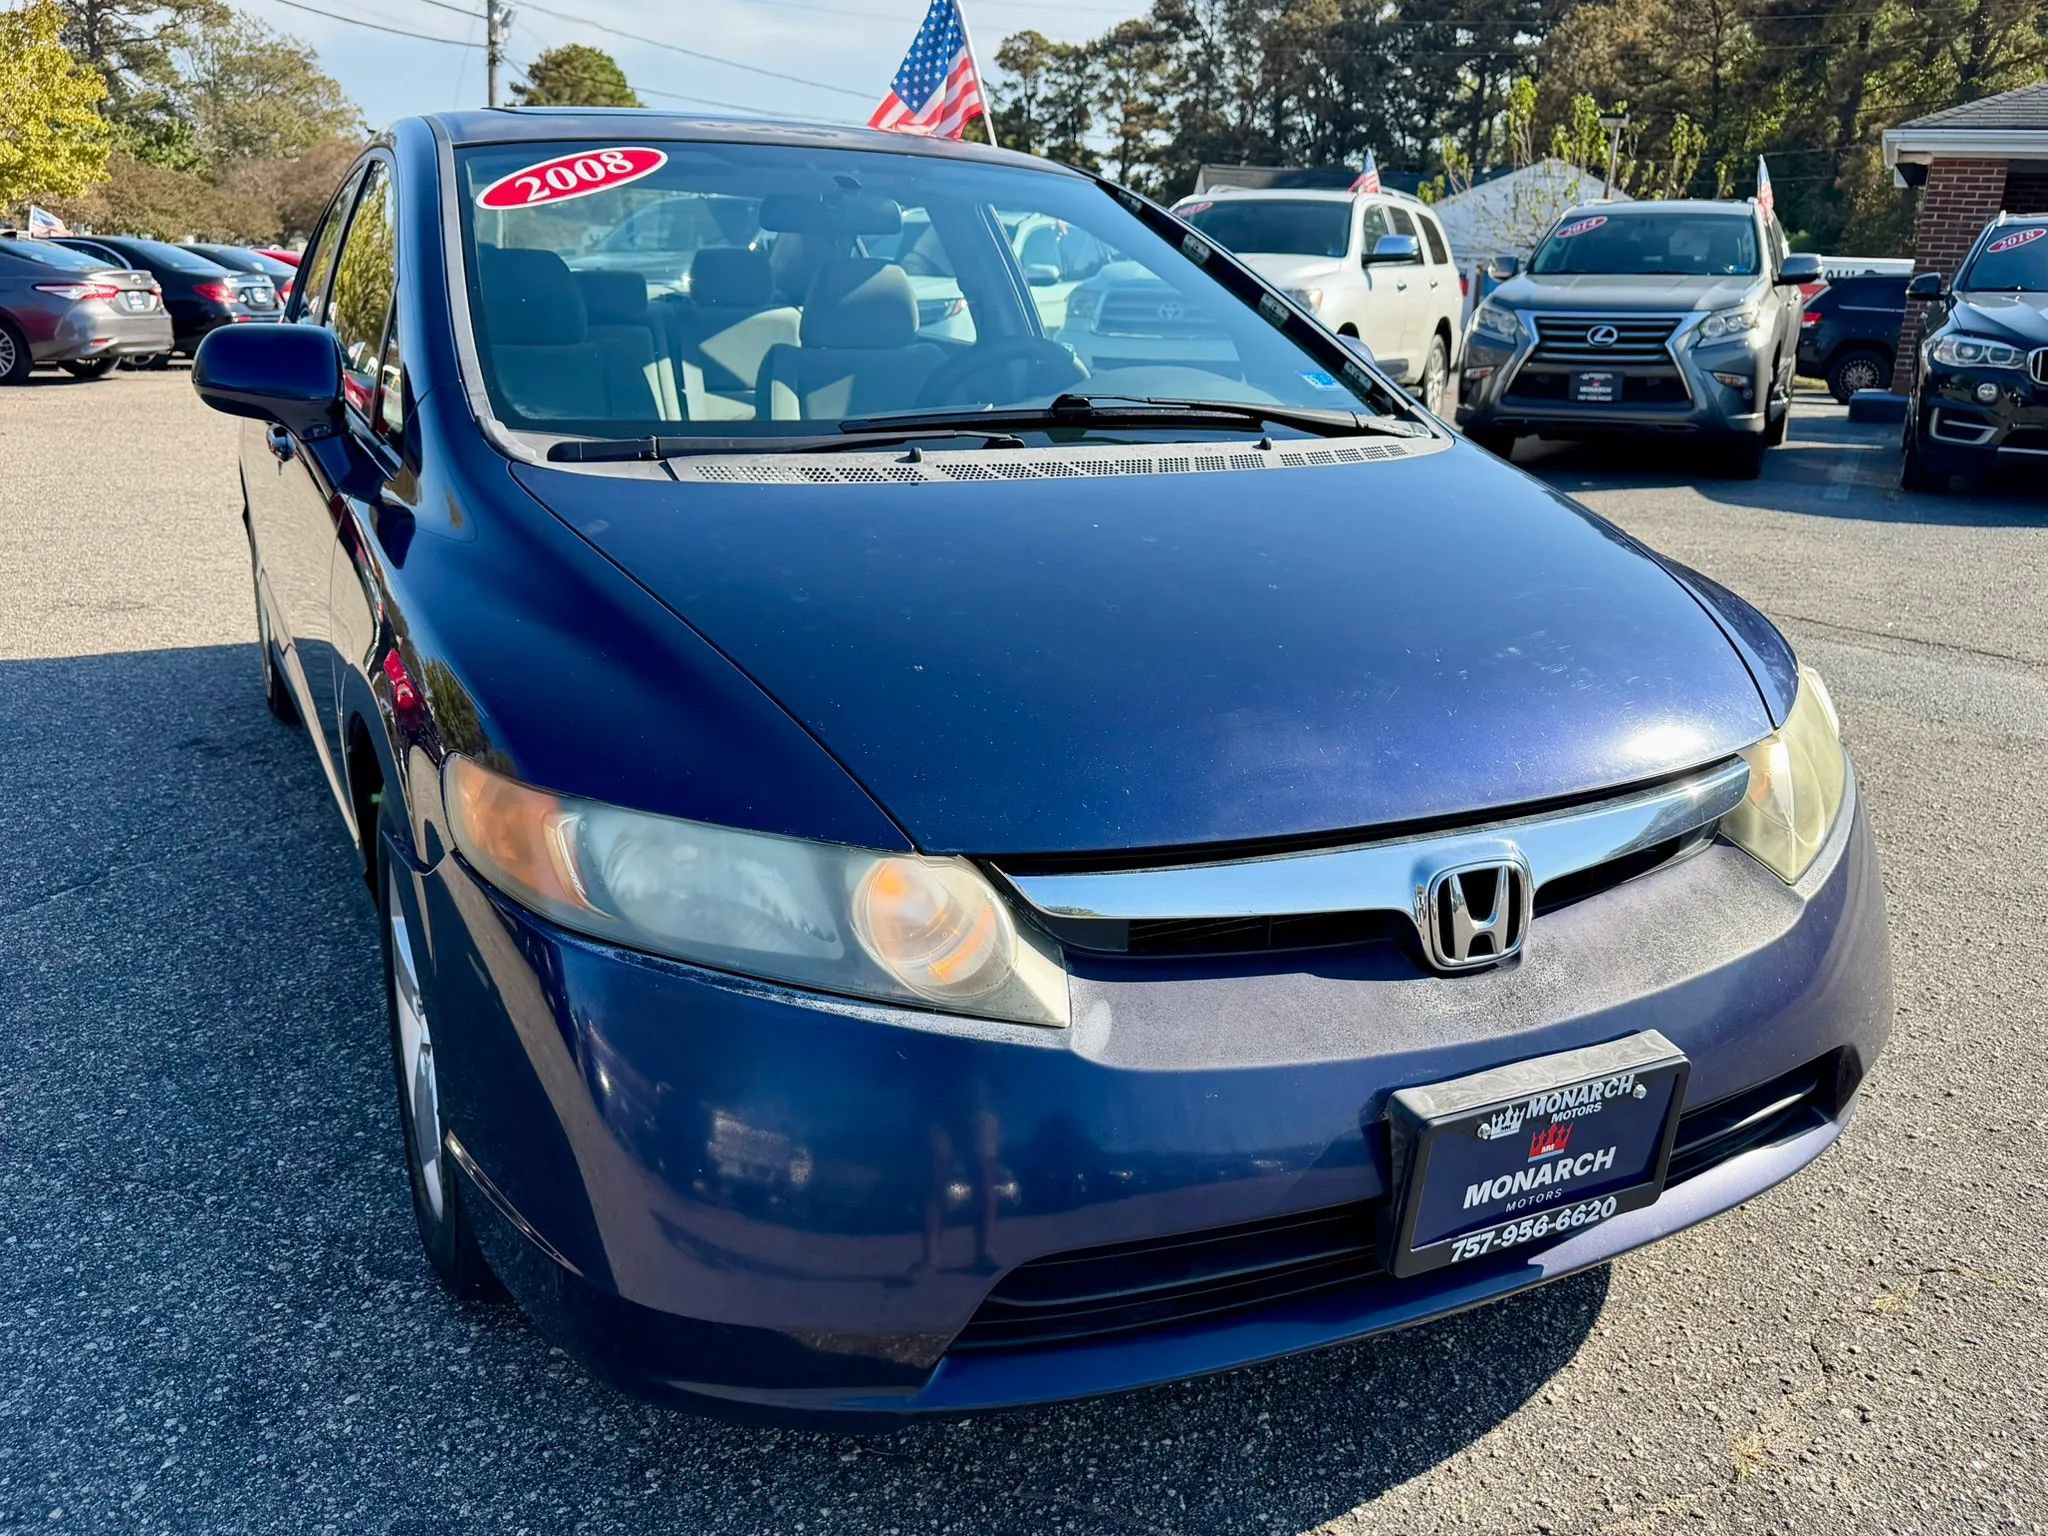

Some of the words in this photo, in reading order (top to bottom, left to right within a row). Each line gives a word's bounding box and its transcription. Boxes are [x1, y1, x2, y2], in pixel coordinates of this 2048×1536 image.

[514, 151, 634, 202] 2008
[1999, 230, 2035, 250] 2018
[1525, 1074, 1635, 1119] MONARCH
[1550, 1102, 1603, 1124] MOTORS
[1462, 1146, 1617, 1209] MONARCH
[1505, 1187, 1563, 1213] MOTORS
[1450, 1195, 1617, 1263] 757-956-6620
